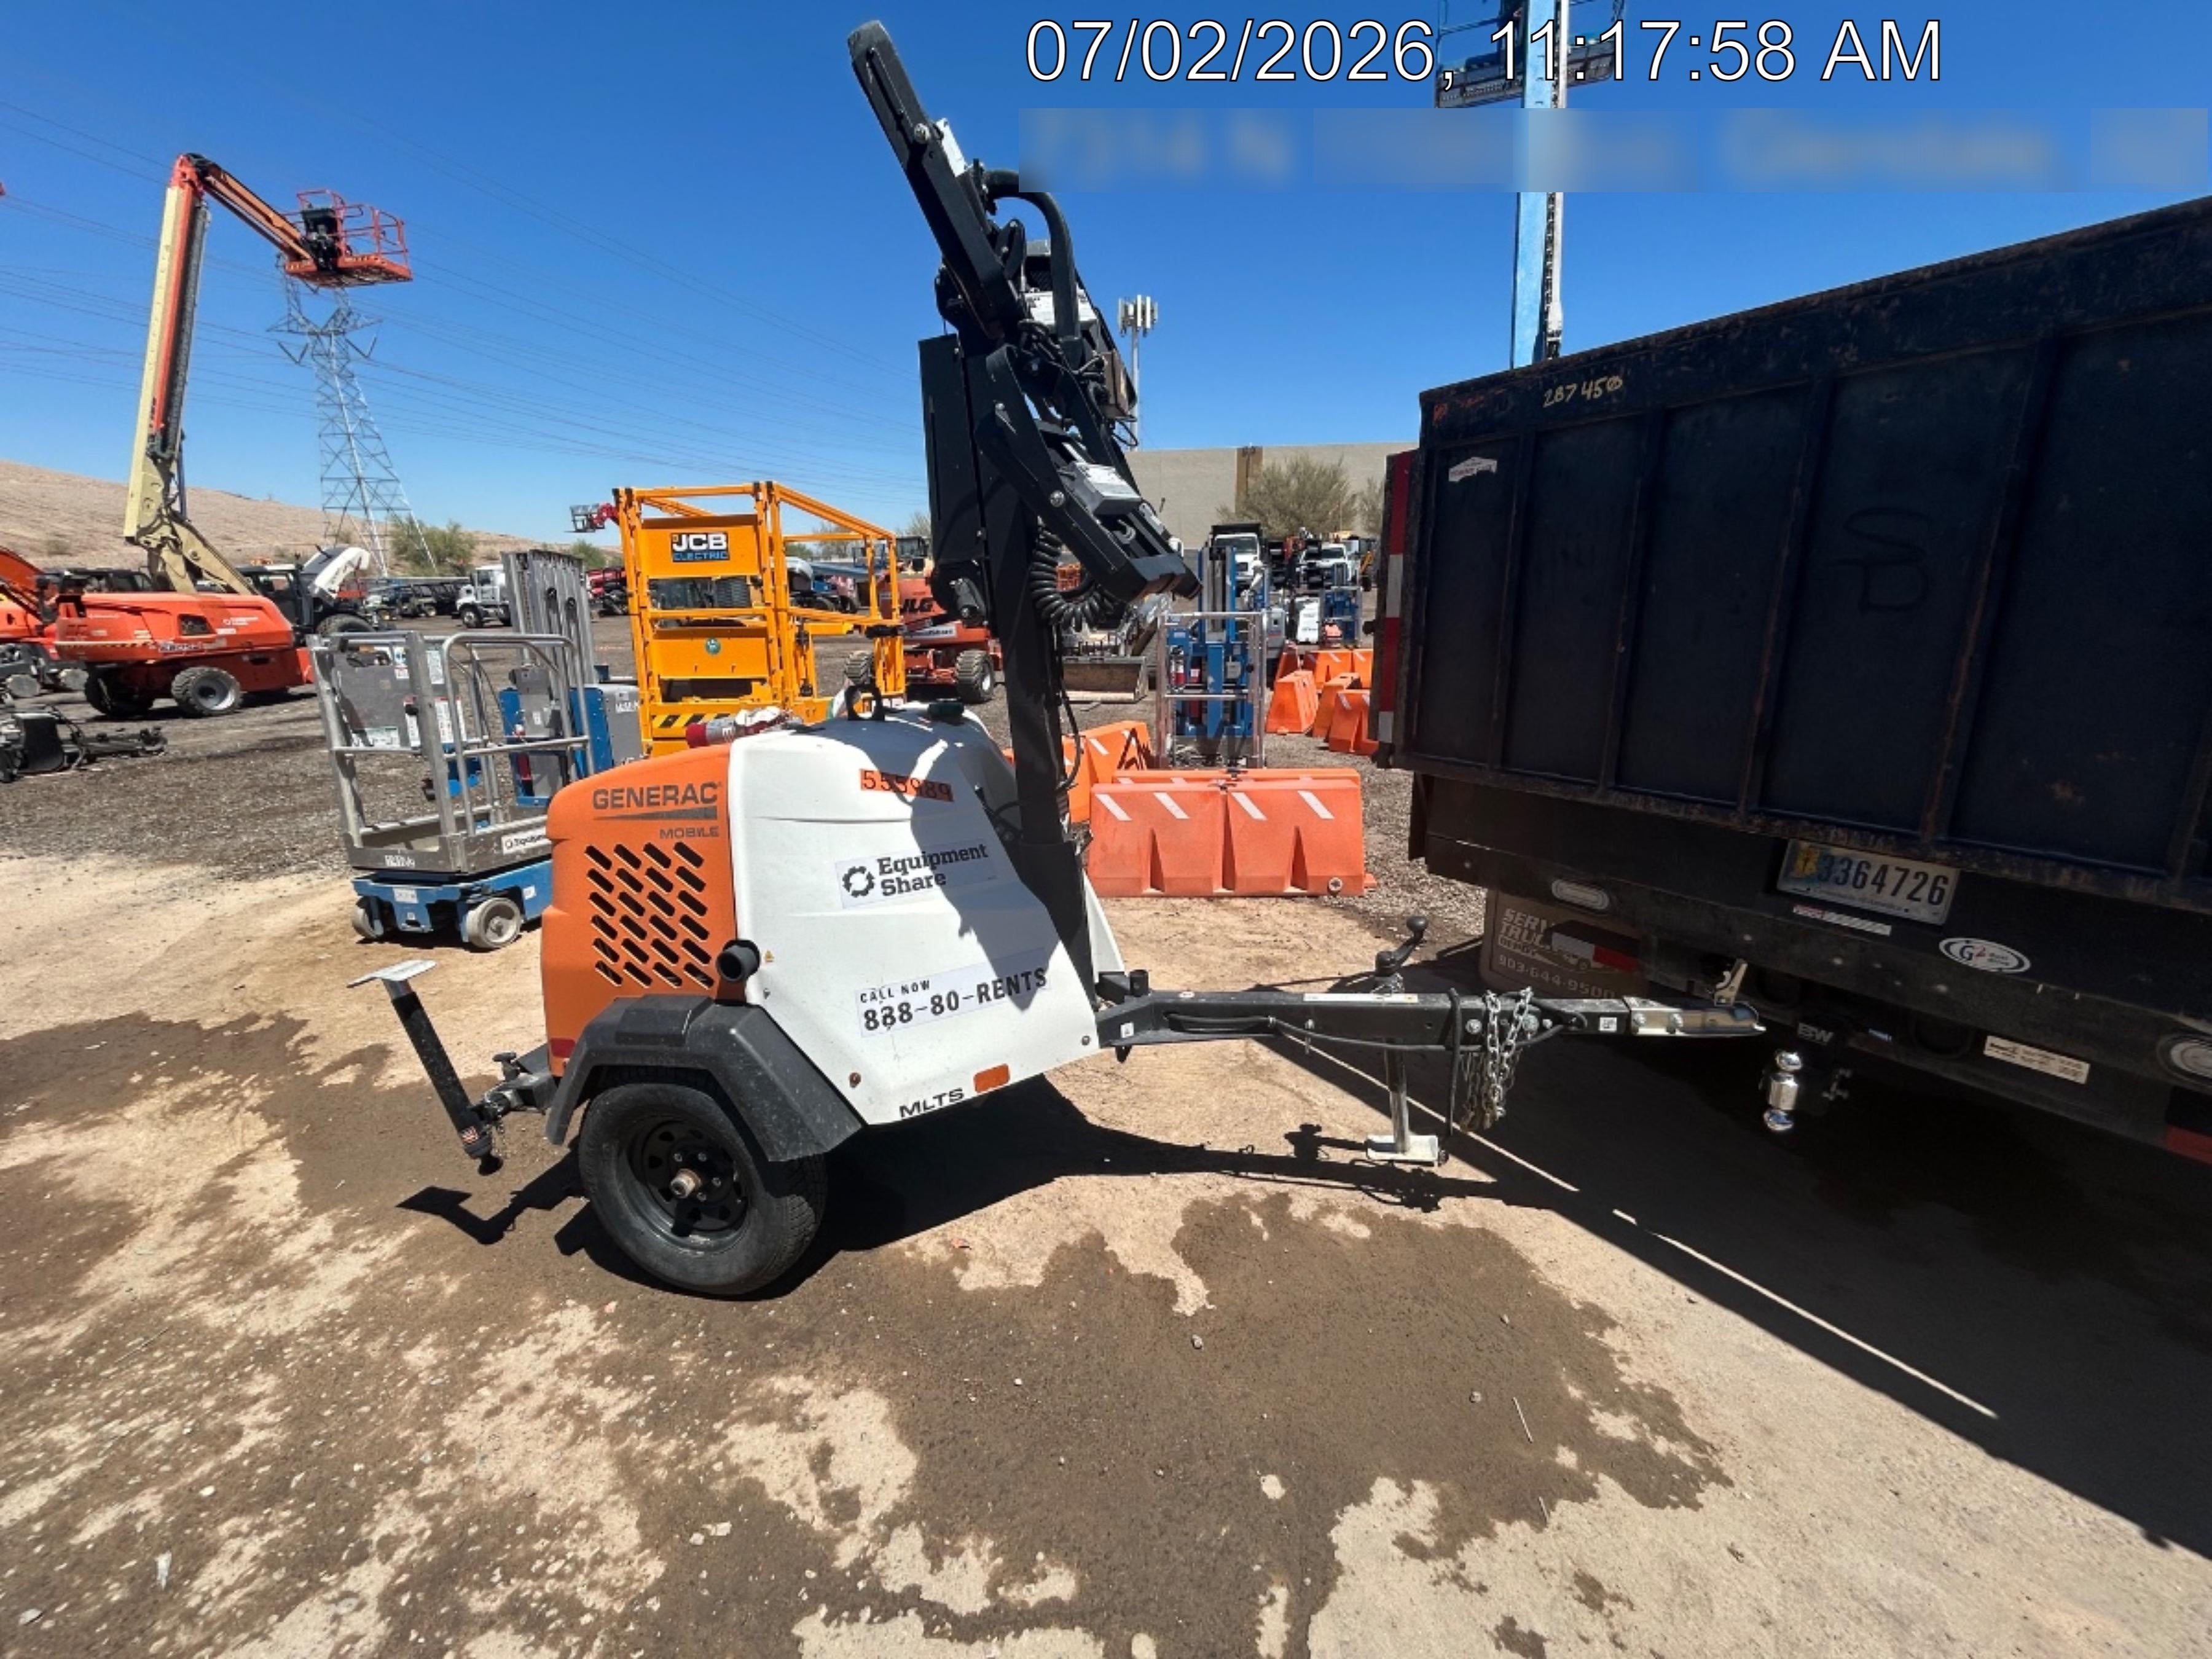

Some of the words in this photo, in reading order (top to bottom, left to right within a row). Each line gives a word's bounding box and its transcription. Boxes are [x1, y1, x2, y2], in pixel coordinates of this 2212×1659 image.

[672, 533, 728, 551] JCB
[673, 551, 729, 561] ELECTRIC
[900, 597, 933, 613] JLG
[592, 782, 718, 810] GENERAC
[863, 769, 953, 802] 555989
[659, 826, 719, 839] MOBILE
[877, 844, 989, 876] Equipment
[880, 873, 947, 896] Share
[1817, 853, 1950, 906] 3364726
[860, 987, 895, 1003] CALL
[901, 979, 930, 994] NOW
[863, 967, 1048, 1031] 888-80-RENTS
[898, 1087, 965, 1118] MLTS
